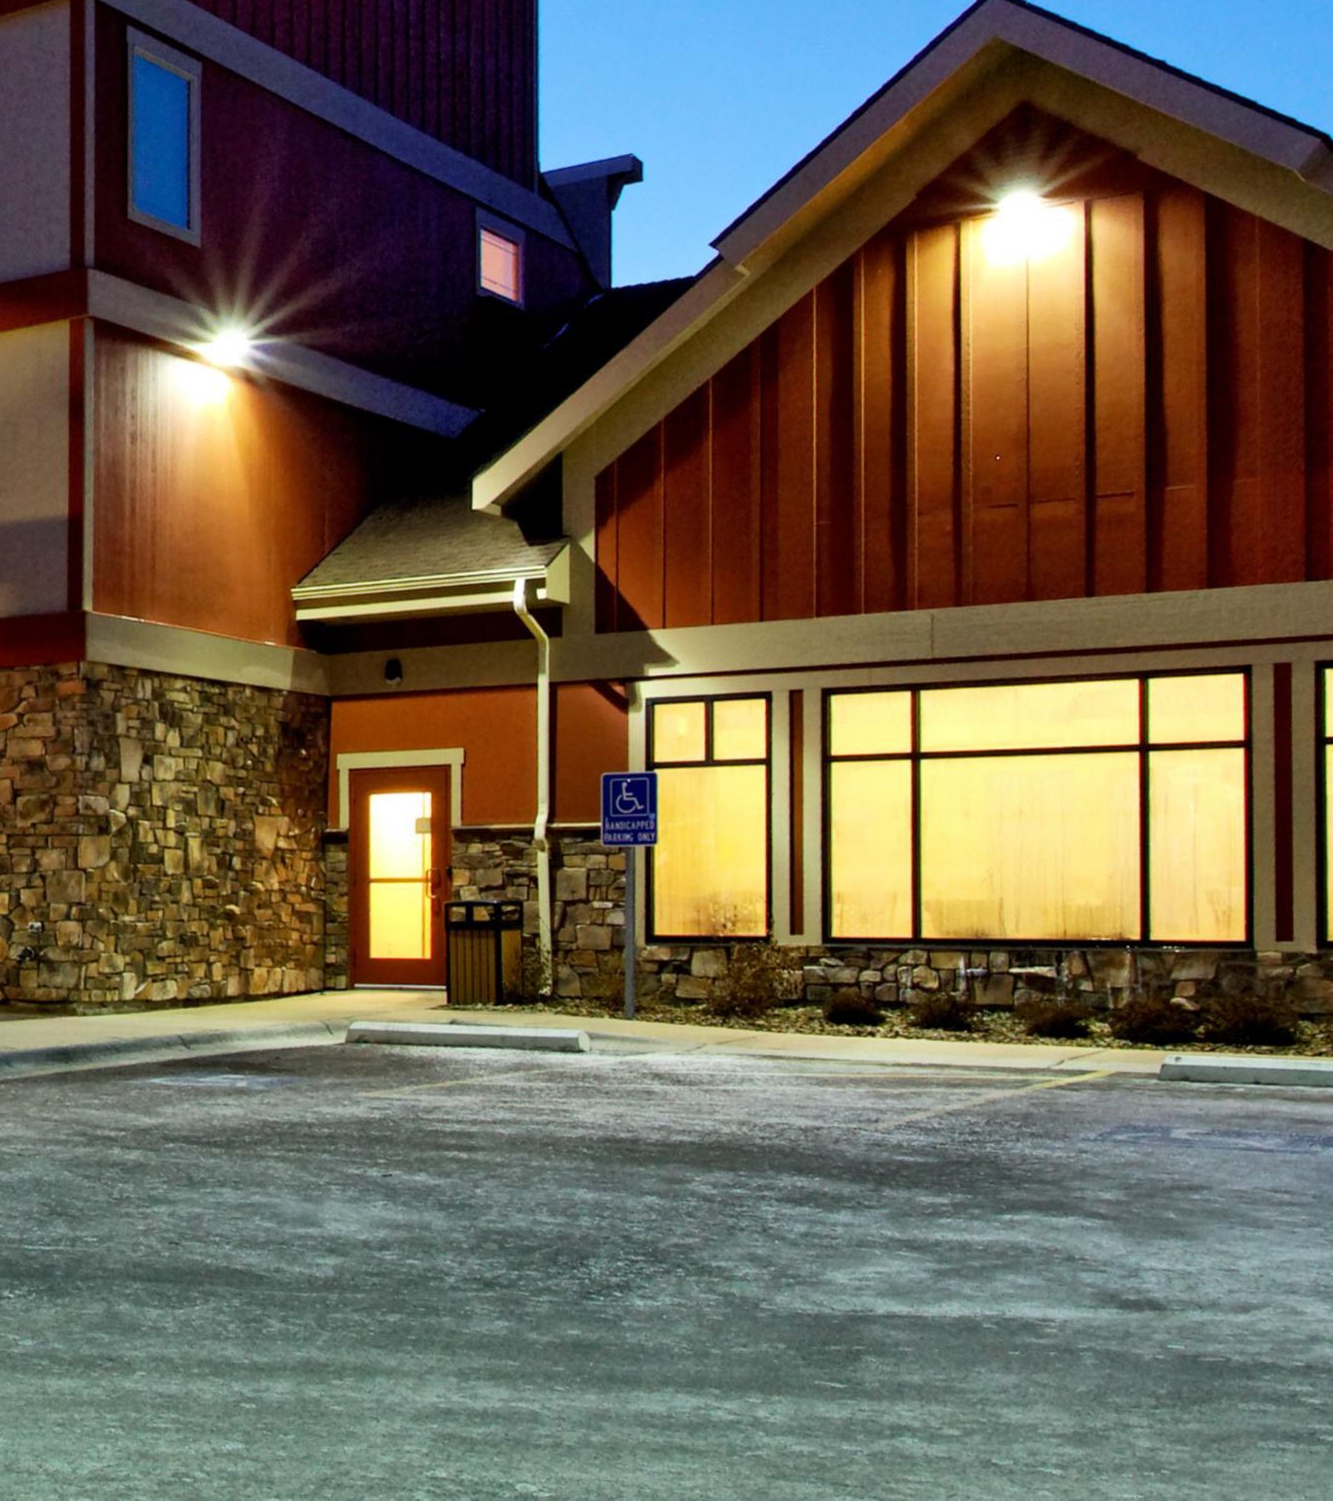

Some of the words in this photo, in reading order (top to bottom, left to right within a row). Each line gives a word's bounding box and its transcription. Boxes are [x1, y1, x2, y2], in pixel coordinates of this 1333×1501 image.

[605, 820, 655, 830] HANDICAPPED
[604, 833, 634, 842] PARKING
[637, 832, 655, 842] ONLY
